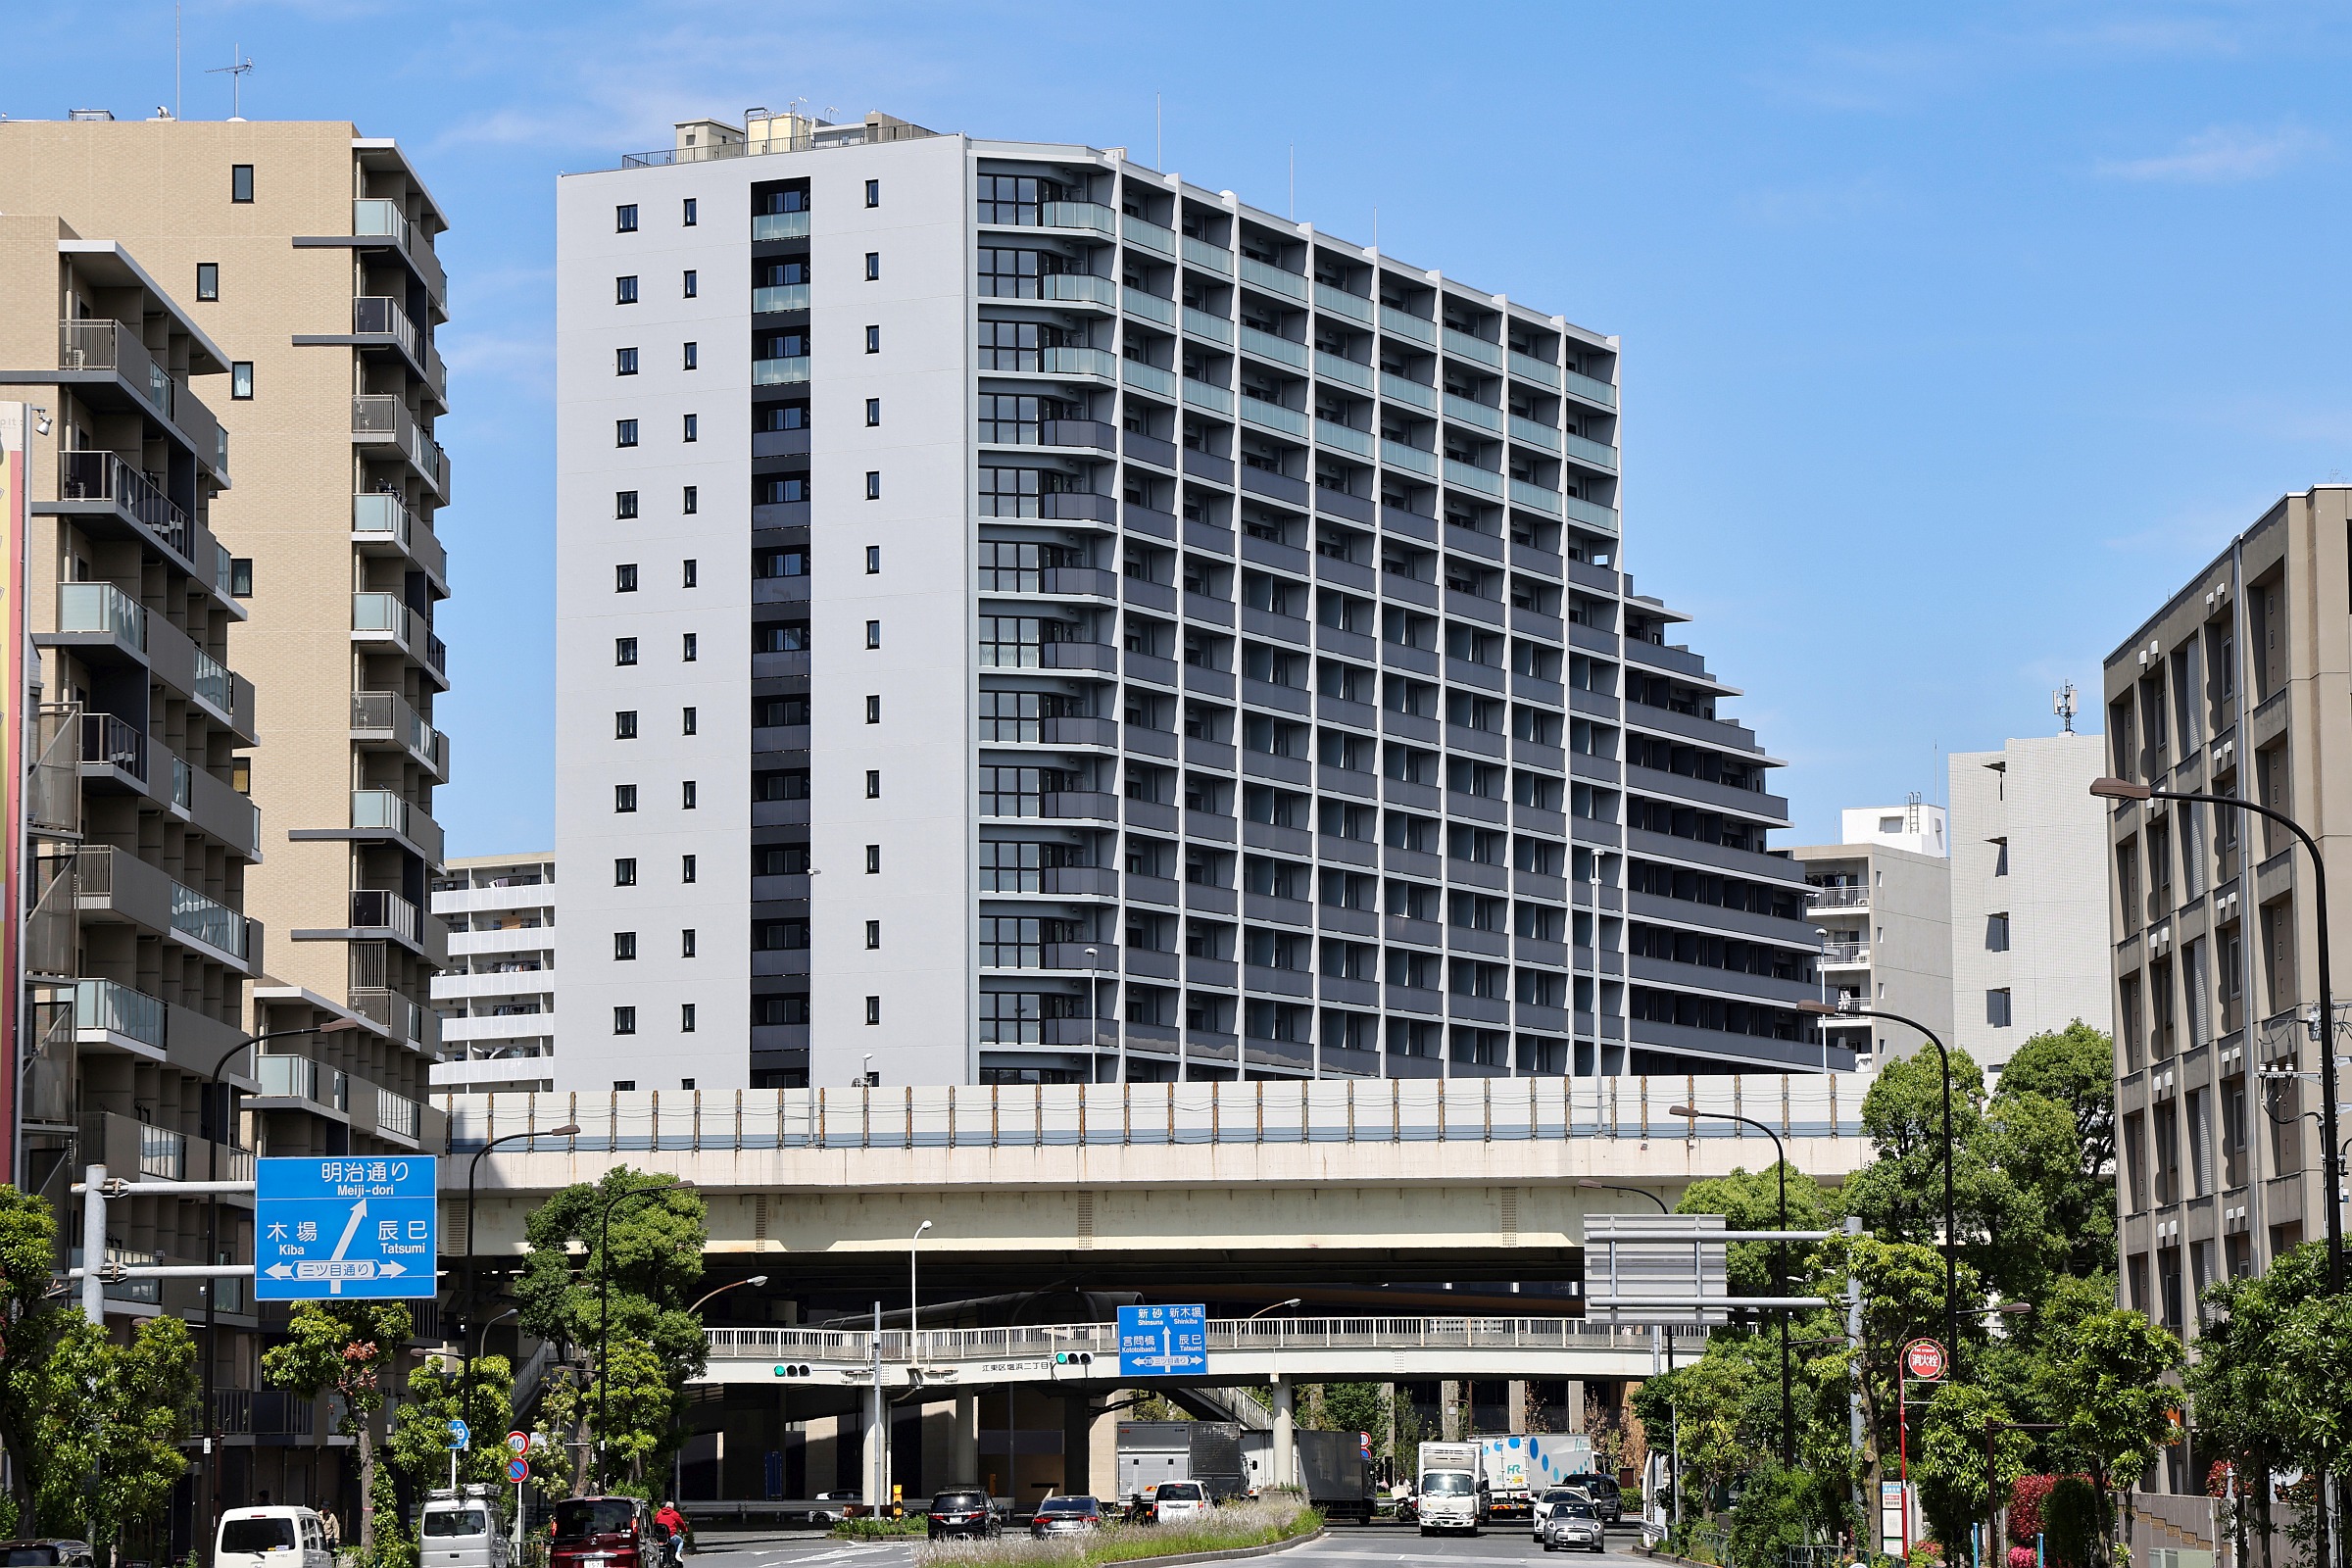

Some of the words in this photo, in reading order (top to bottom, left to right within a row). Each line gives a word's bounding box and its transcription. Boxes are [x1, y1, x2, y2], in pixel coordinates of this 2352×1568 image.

[321, 1161, 409, 1183] 明治通り
[337, 1184, 394, 1198] Meiji-dori
[267, 1221, 318, 1243] 木場
[377, 1220, 428, 1241] 辰巳
[278, 1245, 305, 1255] Kiba
[380, 1243, 425, 1254] Tatsumi
[302, 1263, 369, 1277] 三ツ目通り
[1138, 1307, 1163, 1319] 新砂
[1169, 1306, 1202, 1318] 新木場
[1122, 1335, 1155, 1347] 言問橋
[1179, 1334, 1202, 1346] 辰巳
[1912, 1353, 1938, 1367] 消火栓
[982, 1361, 1049, 1372] 江東区塩浜二丁目
